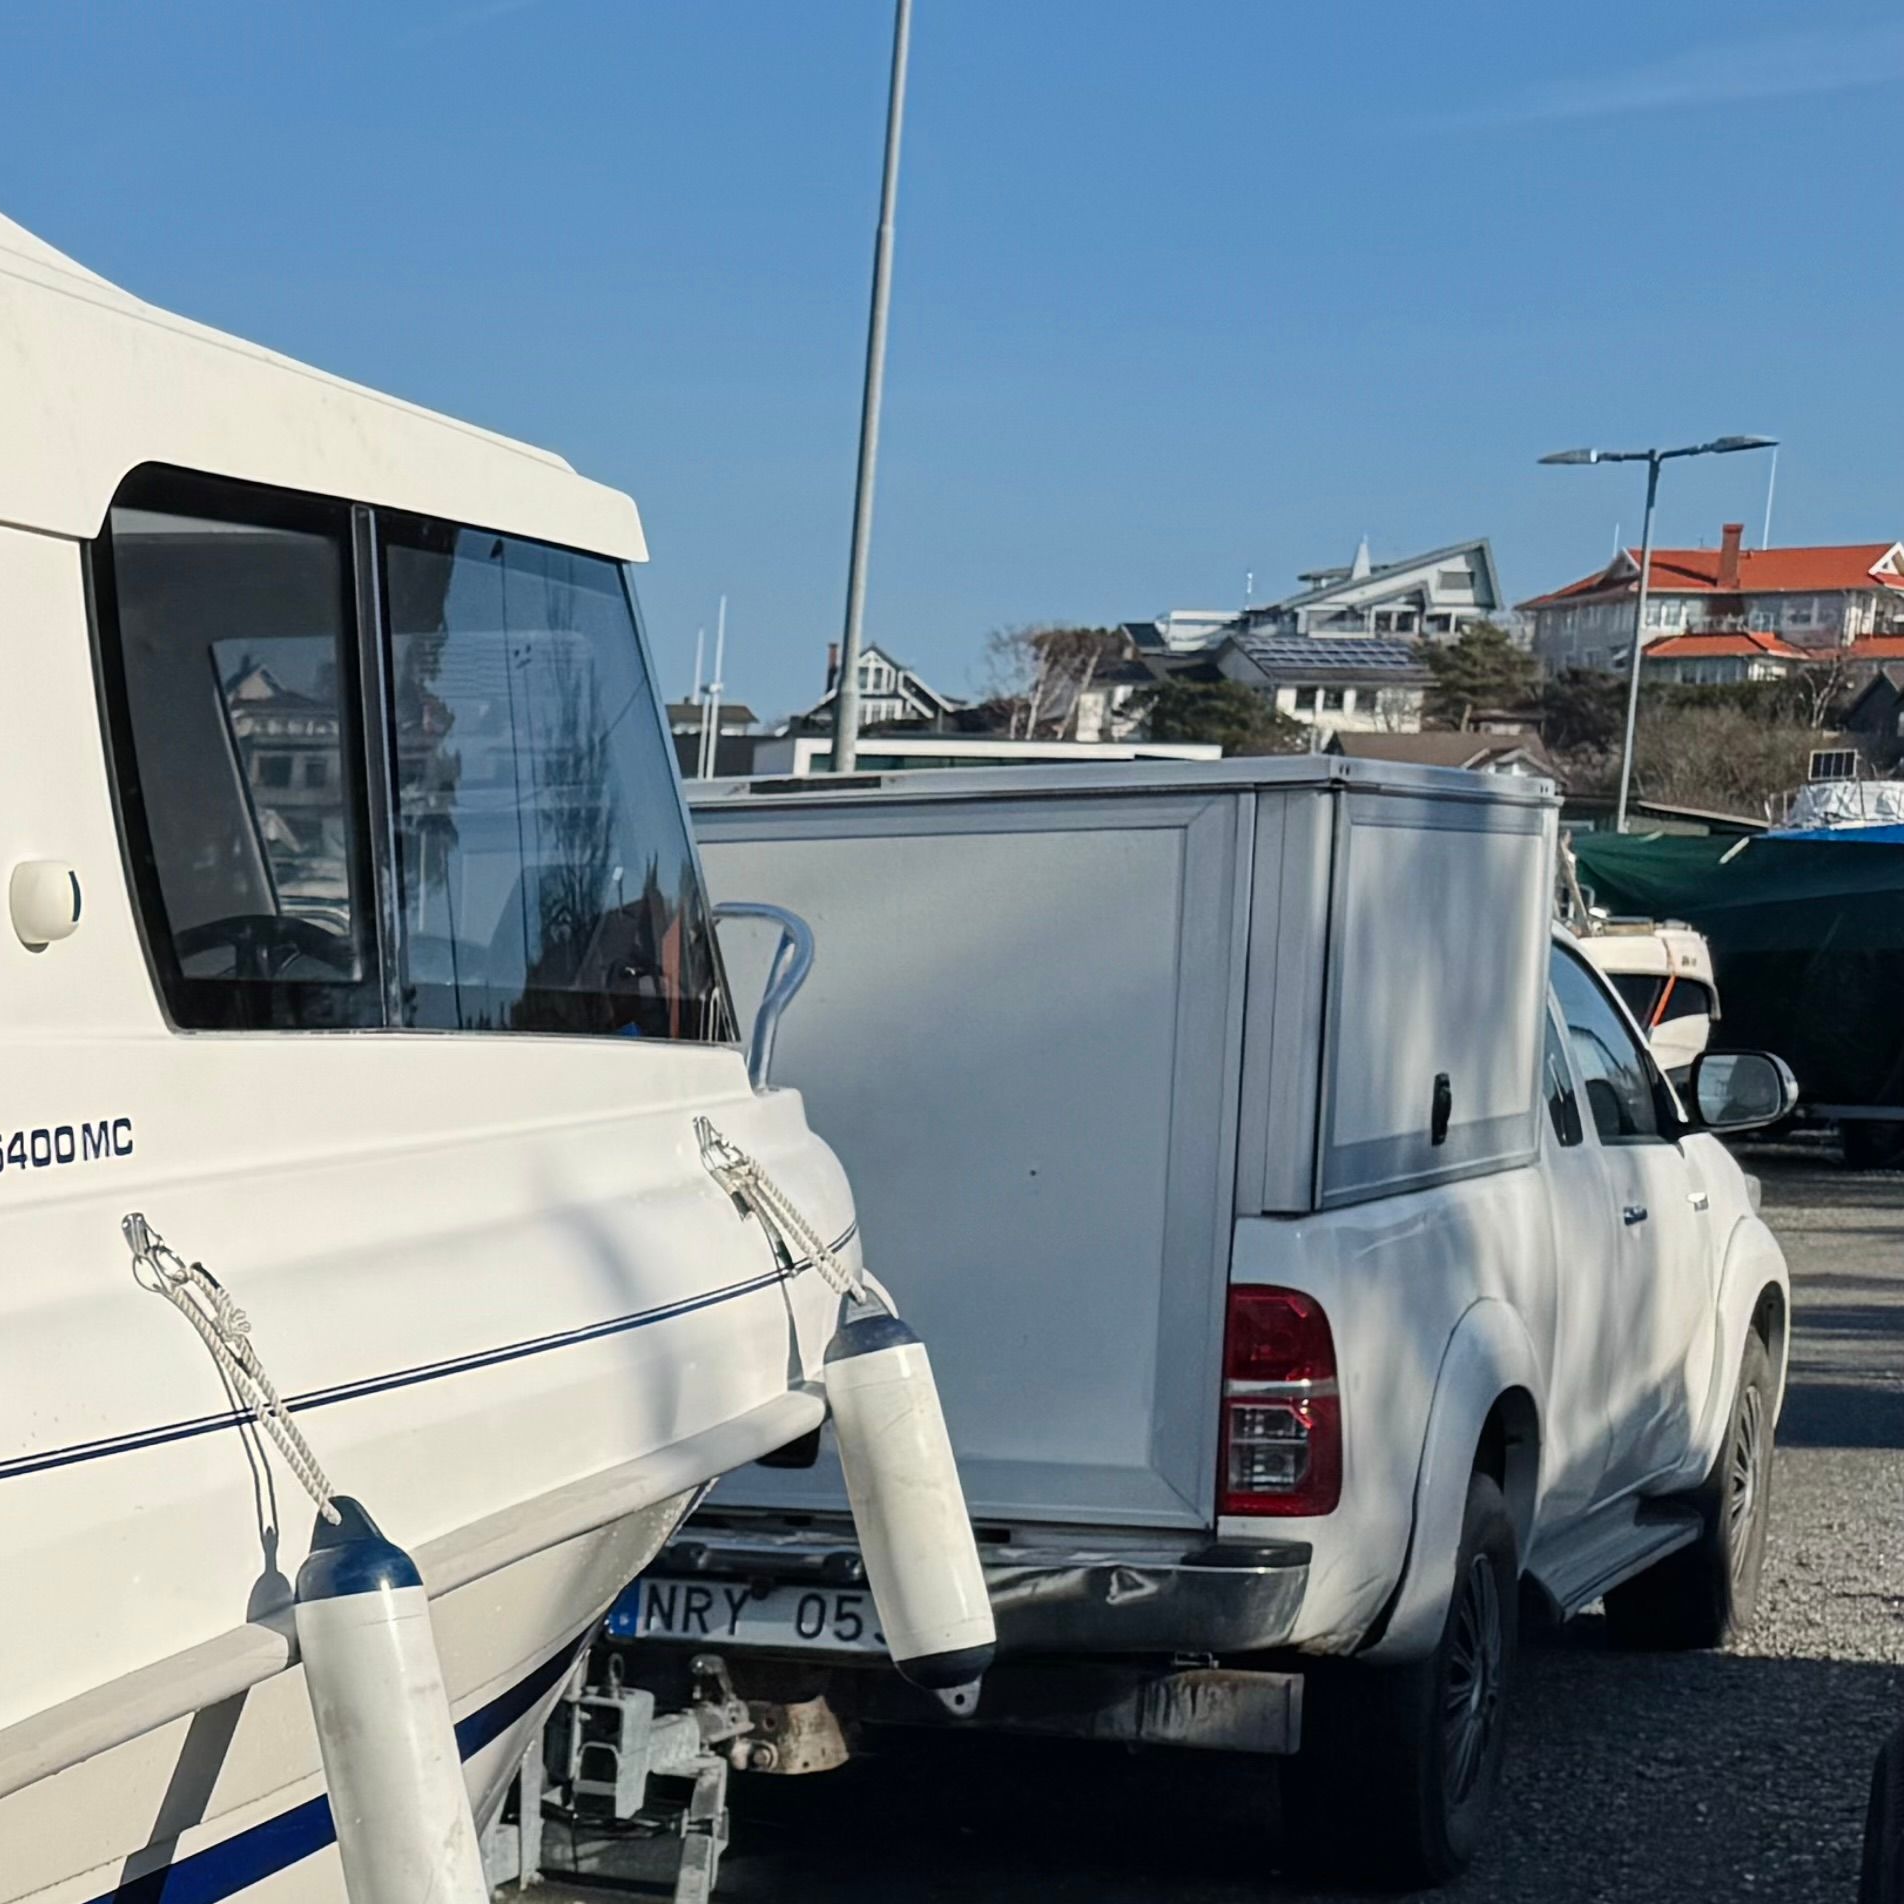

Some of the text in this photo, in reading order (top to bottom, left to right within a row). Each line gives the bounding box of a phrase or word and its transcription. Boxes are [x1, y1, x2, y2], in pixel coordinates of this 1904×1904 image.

[81, 1117, 133, 1161] MC
[645, 1583, 887, 1646] NRY 05
